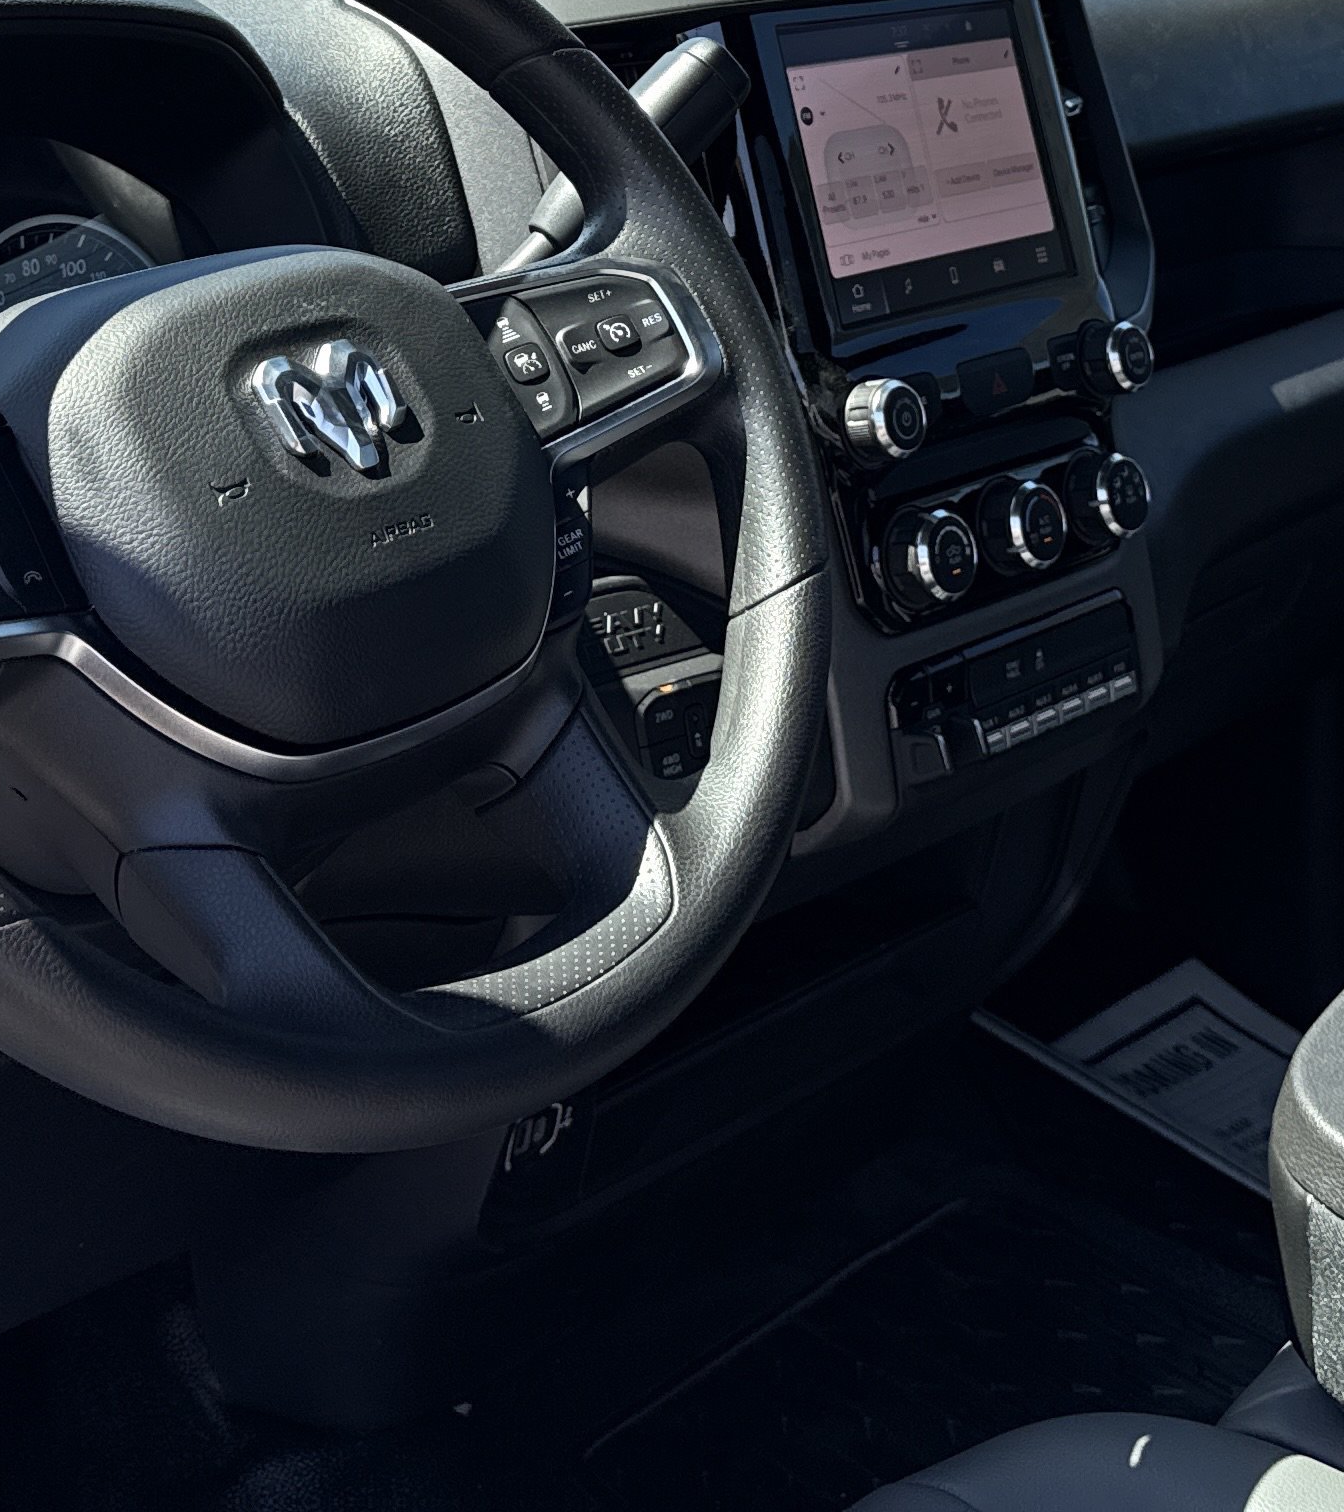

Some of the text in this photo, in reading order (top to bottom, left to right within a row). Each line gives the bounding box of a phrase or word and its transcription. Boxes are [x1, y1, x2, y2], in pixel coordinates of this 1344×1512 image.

[21, 257, 41, 277] 80
[60, 258, 87, 278] 100
[642, 311, 663, 328] RES
[571, 338, 597, 356] CANC
[371, 513, 435, 548] AIRBAG
[558, 527, 583, 547] GEAR
[558, 539, 583, 560] LIMIT
